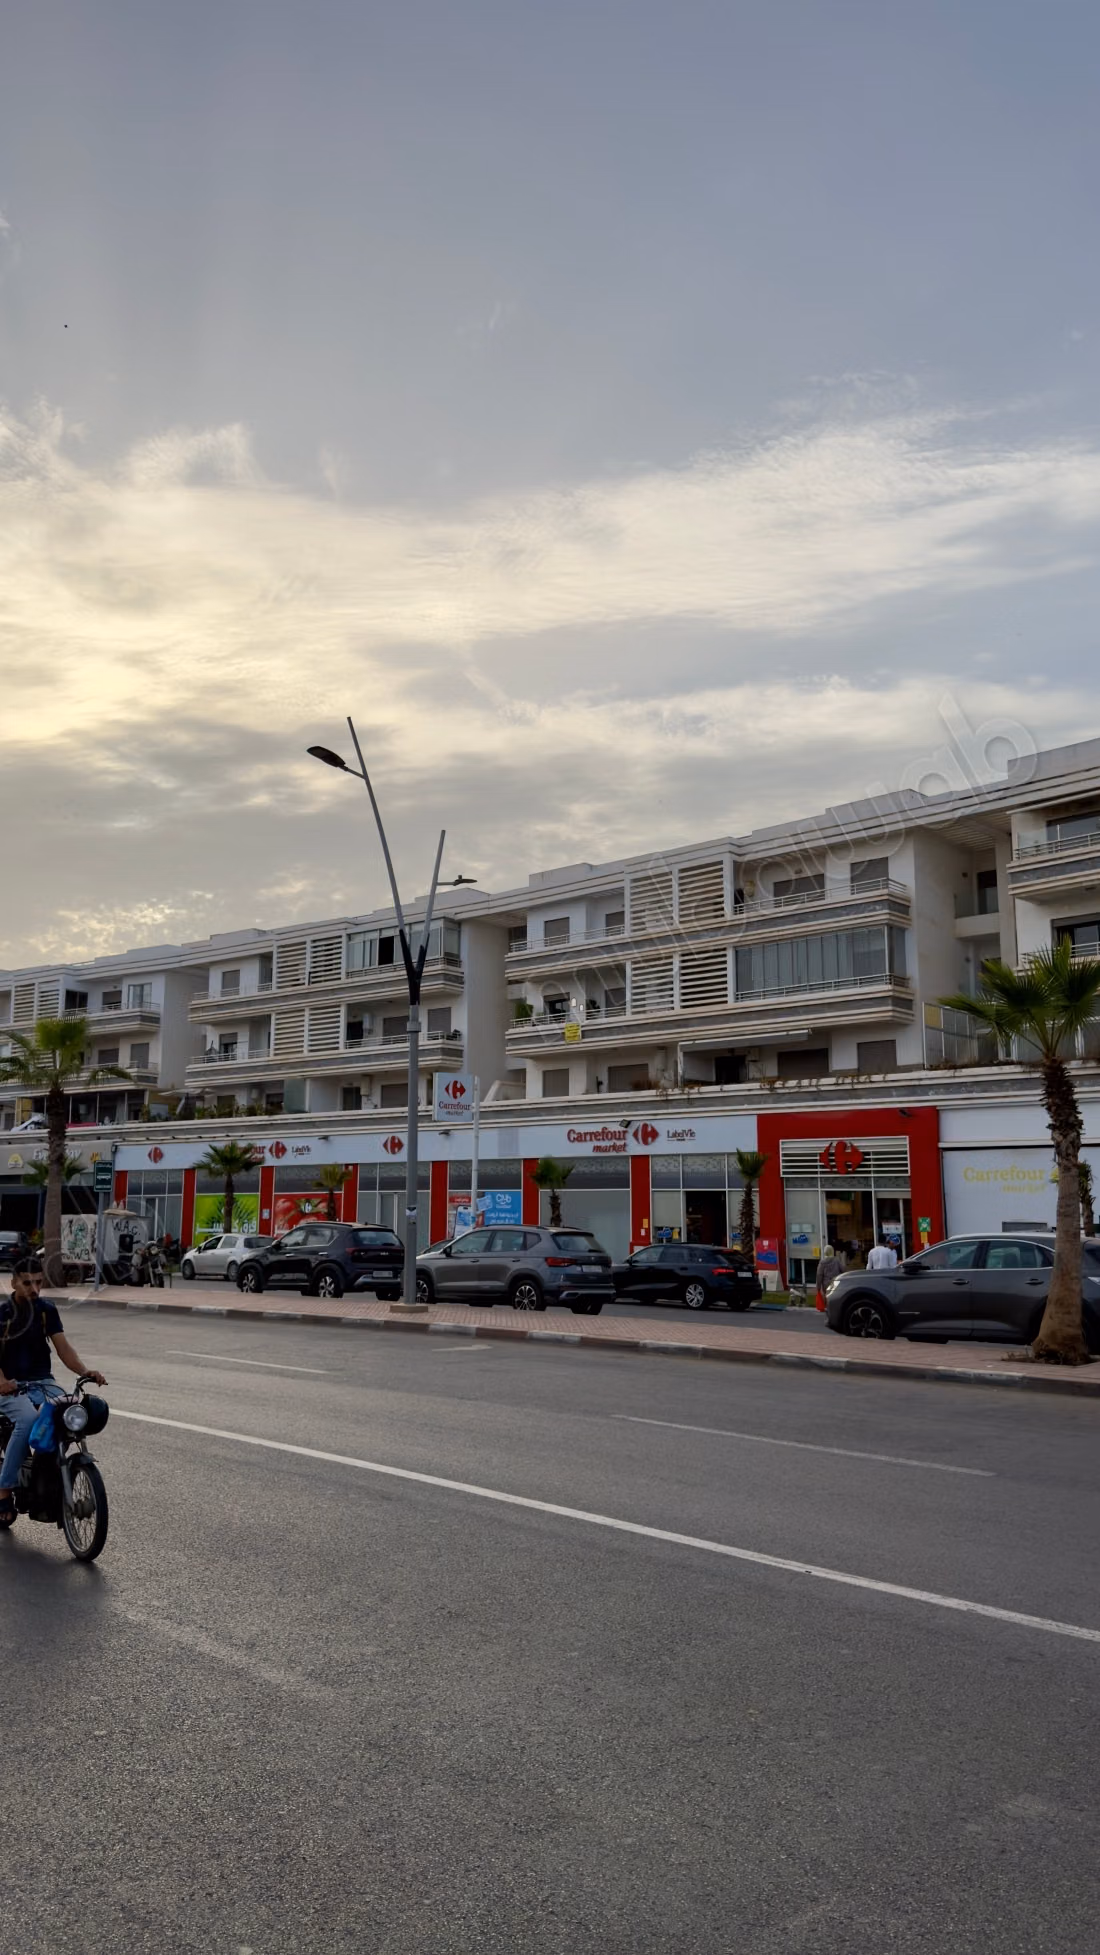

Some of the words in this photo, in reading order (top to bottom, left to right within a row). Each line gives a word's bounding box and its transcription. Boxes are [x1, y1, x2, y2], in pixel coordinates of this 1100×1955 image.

[438, 1101, 471, 1110] Carrefour
[567, 1126, 629, 1143] Carrefour
[592, 1141, 627, 1153] market
[963, 1165, 1045, 1181] Carrefour
